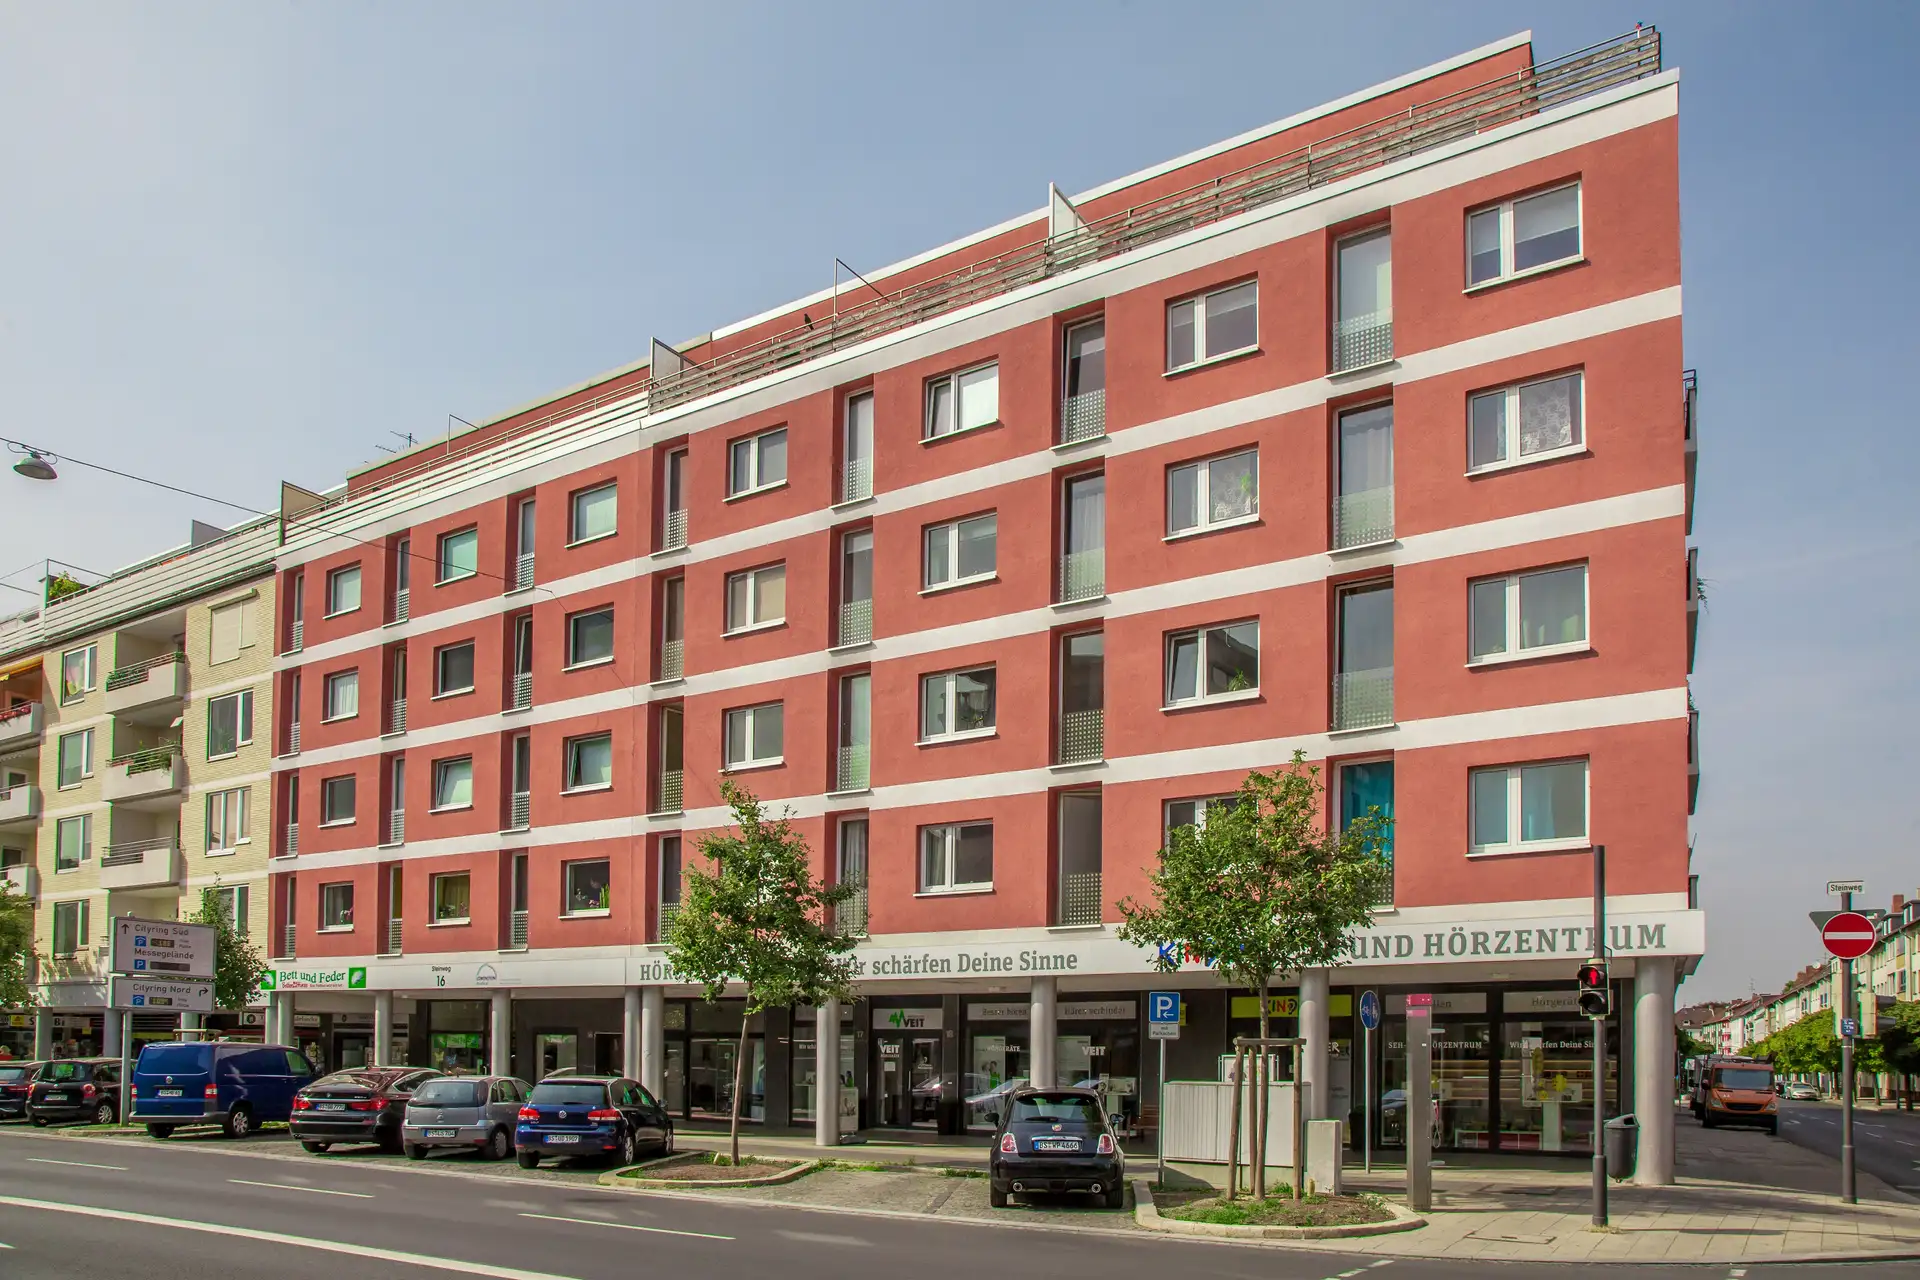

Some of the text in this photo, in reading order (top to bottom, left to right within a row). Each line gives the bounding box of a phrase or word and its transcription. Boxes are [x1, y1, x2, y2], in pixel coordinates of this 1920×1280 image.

[1830, 884, 1862, 893] Steinweg
[134, 924, 189, 936] Cityring Süd
[1350, 934, 1414, 960] UND
[134, 948, 194, 959] Messegelände
[872, 953, 951, 975] schärfen
[957, 951, 1013, 973] Deine
[1019, 950, 1078, 971] Sinne
[431, 965, 451, 973] Steinweg
[280, 970, 346, 983] Bett und Feder
[436, 975, 446, 987] 16
[132, 983, 191, 994] Cityring Nord
[904, 1018, 925, 1028] VEIT
[880, 1044, 900, 1054] VEIT
[1432, 1040, 1482, 1049] ÖRZENTRUM
[1559, 1040, 1582, 1049] Deine
[1082, 1046, 1106, 1056] VEIT
